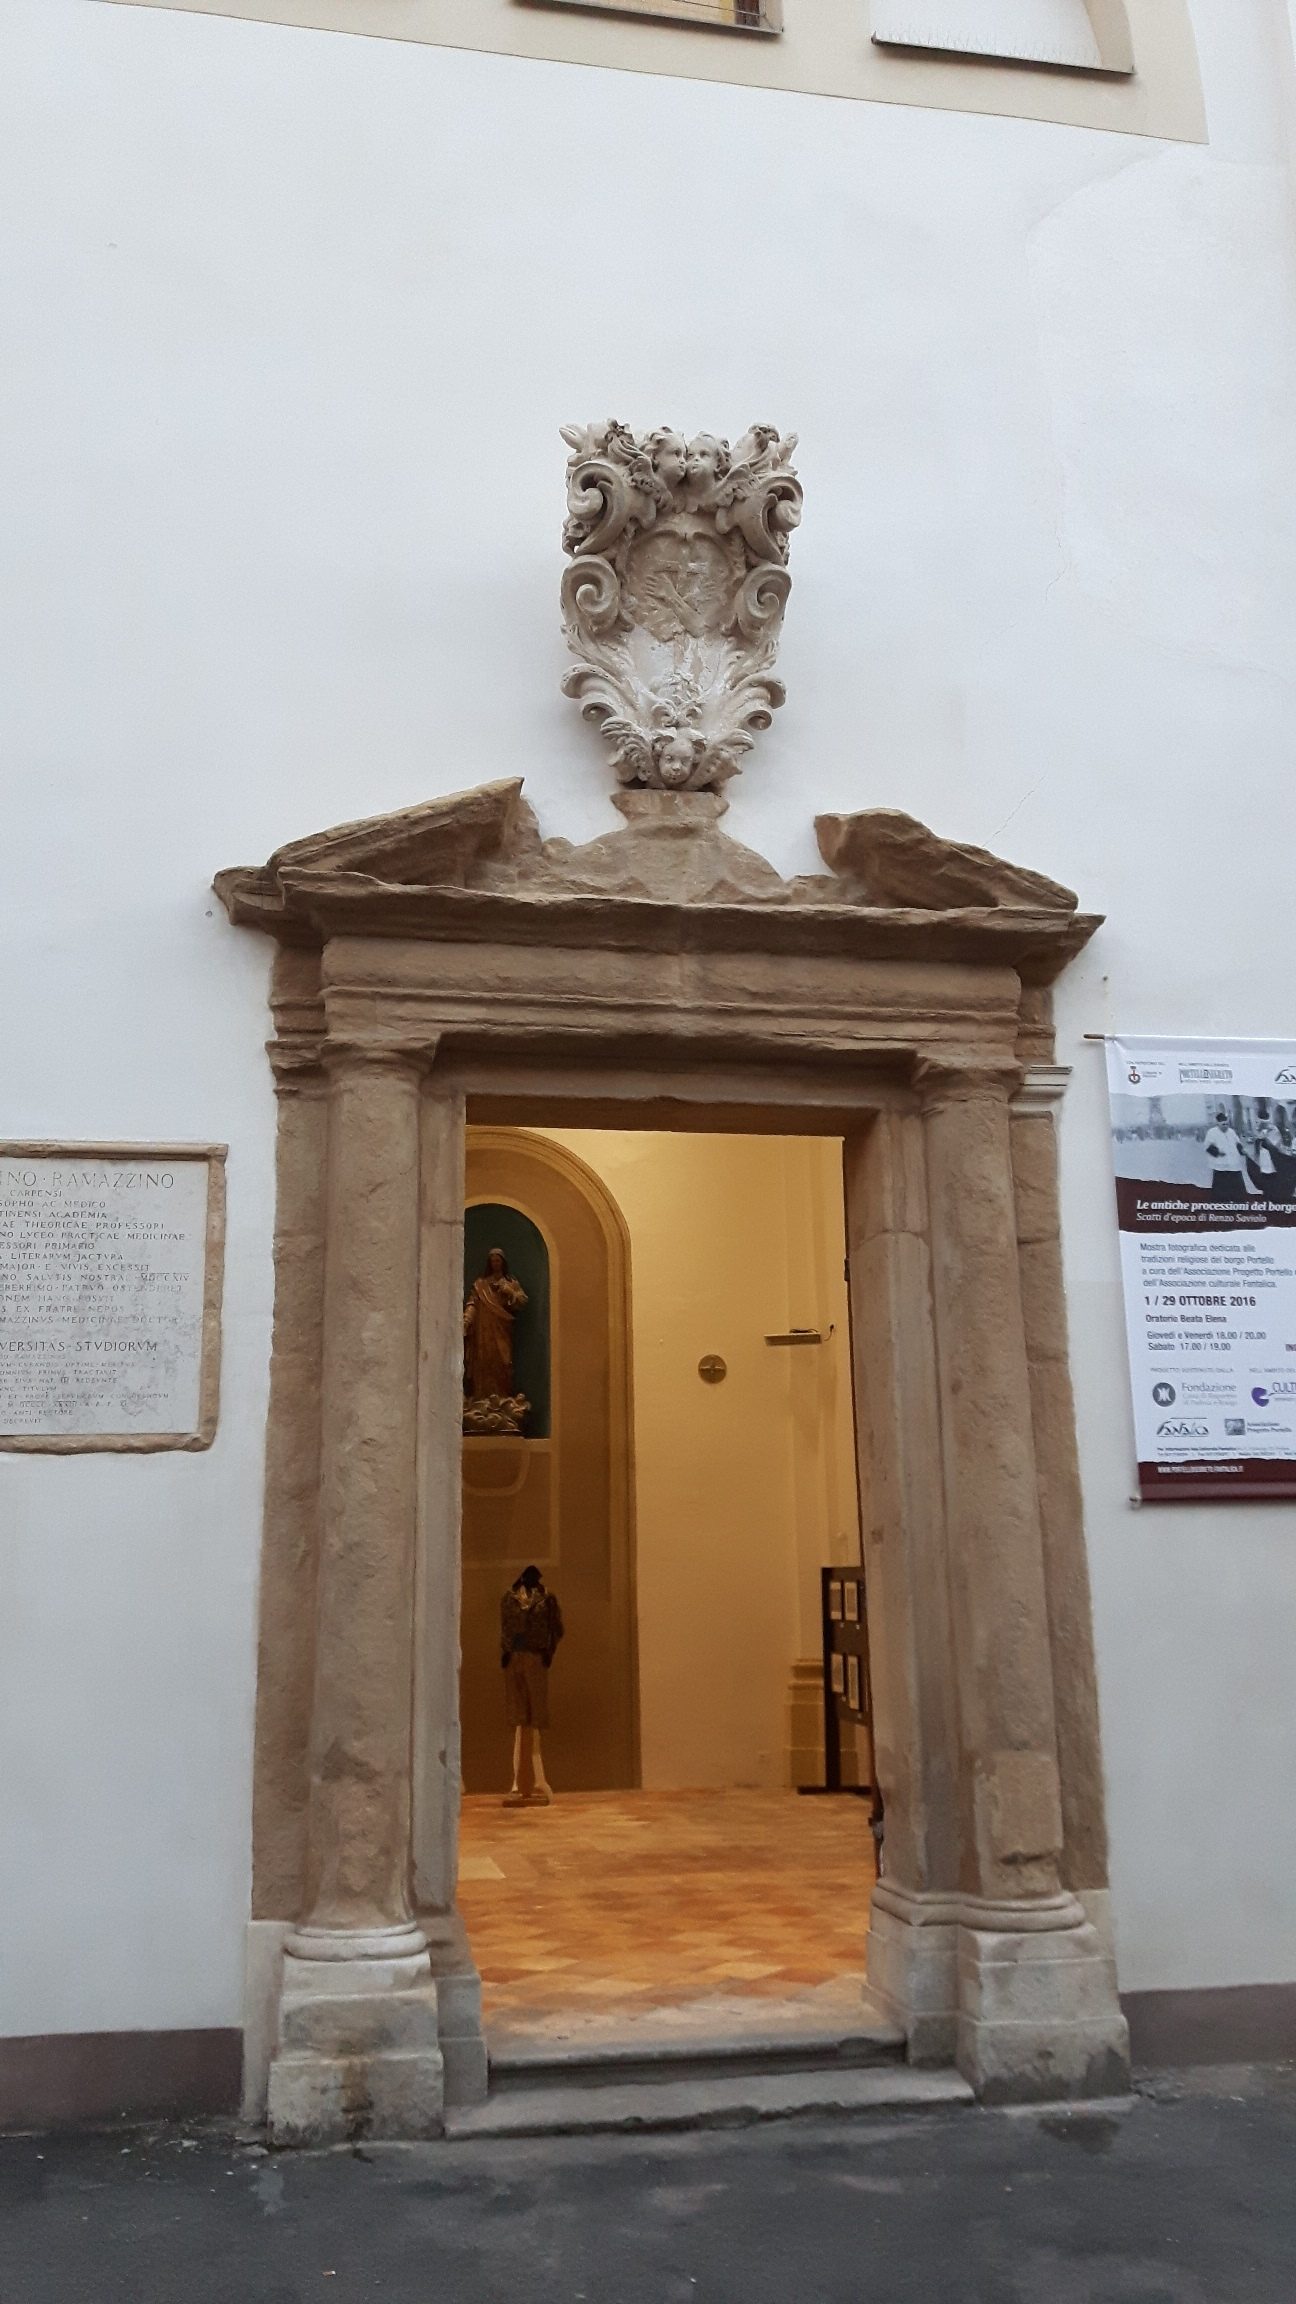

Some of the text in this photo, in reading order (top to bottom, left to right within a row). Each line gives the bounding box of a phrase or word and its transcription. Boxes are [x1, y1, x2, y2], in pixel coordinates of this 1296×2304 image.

[52, 1171, 174, 1189] RAMAZZINO
[10, 1189, 62, 1198] CARPENSI
[64, 1201, 106, 1209] MEDICO
[1136, 1200, 1149, 1210] Le
[1151, 1201, 1188, 1210] antiche
[1191, 1201, 1249, 1213] processioni
[1250, 1201, 1266, 1211] del
[49, 1211, 107, 1219] ACADEMIA
[1198, 1213, 1206, 1222] di
[25, 1220, 87, 1229] THEORICAE
[95, 1222, 164, 1230] PROFESSORI
[127, 1233, 186, 1241] MEDICINAE
[45, 1242, 95, 1250] PRIMARIO
[1140, 1243, 1166, 1251] Mostra
[1168, 1243, 1207, 1253] fotografica
[1209, 1244, 1240, 1252] dedicata
[1177, 1256, 1209, 1265] religiose
[1210, 1256, 1222, 1264] del
[1224, 1256, 1245, 1265] borgo
[1232, 1268, 1263, 1277] Progetto
[1208, 1280, 1241, 1288] culturale
[1145, 1296, 1150, 1306] 1
[1162, 1296, 1176, 1306] 29
[1178, 1296, 1227, 1306] OTTOBRE
[1229, 1296, 1257, 1307] 2016
[1146, 1314, 1227, 1323] Oratorio Beata Elena
[0, 1341, 158, 1352] VERSITAS STVDIORVM
[1148, 1342, 1175, 1351] Sabato
[1181, 1382, 1237, 1392] Fondazione
